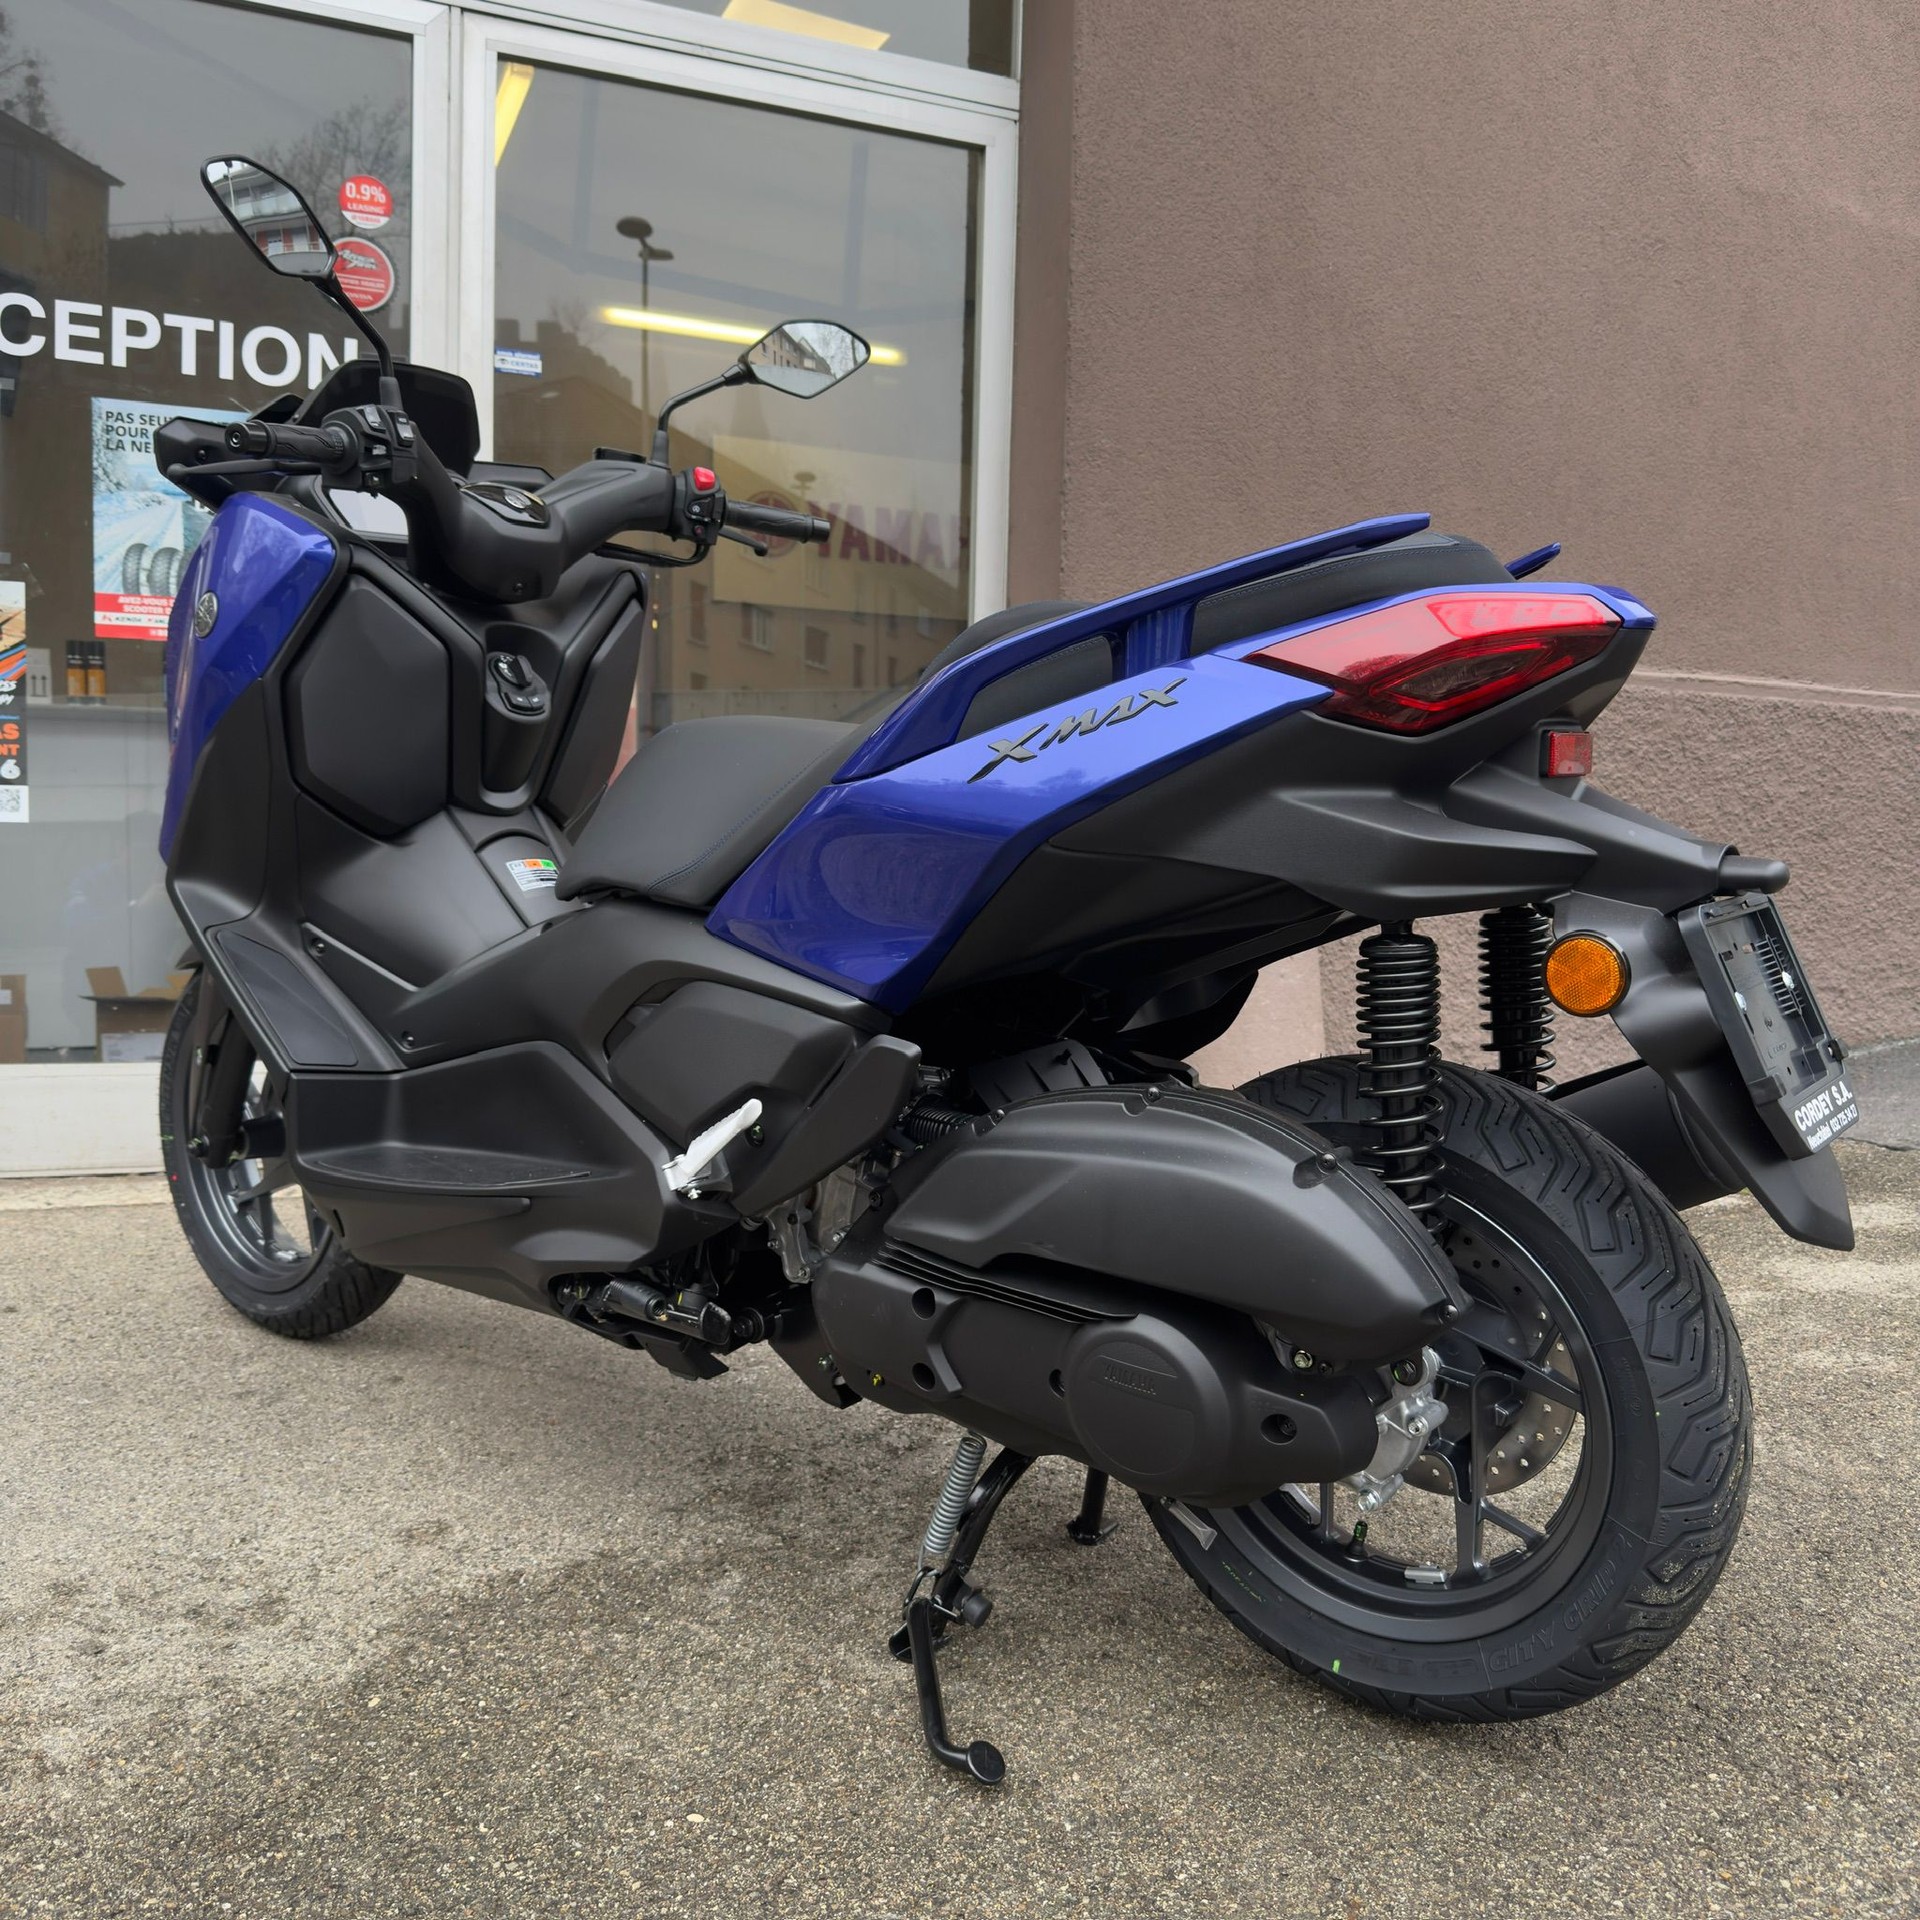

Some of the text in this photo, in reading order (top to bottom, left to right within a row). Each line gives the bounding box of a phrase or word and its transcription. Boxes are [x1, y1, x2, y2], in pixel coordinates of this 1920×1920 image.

[345, 181, 387, 204] 0.9%
[0, 292, 359, 390] CEPTION
[105, 411, 176, 427] PAS SEU
[105, 424, 150, 439] POUR
[105, 438, 127, 451] LA
[0, 723, 20, 740] S
[967, 677, 1188, 784] XMAX
[0, 759, 21, 780] 6
[1794, 1081, 1853, 1131] CORDEY S.A.
